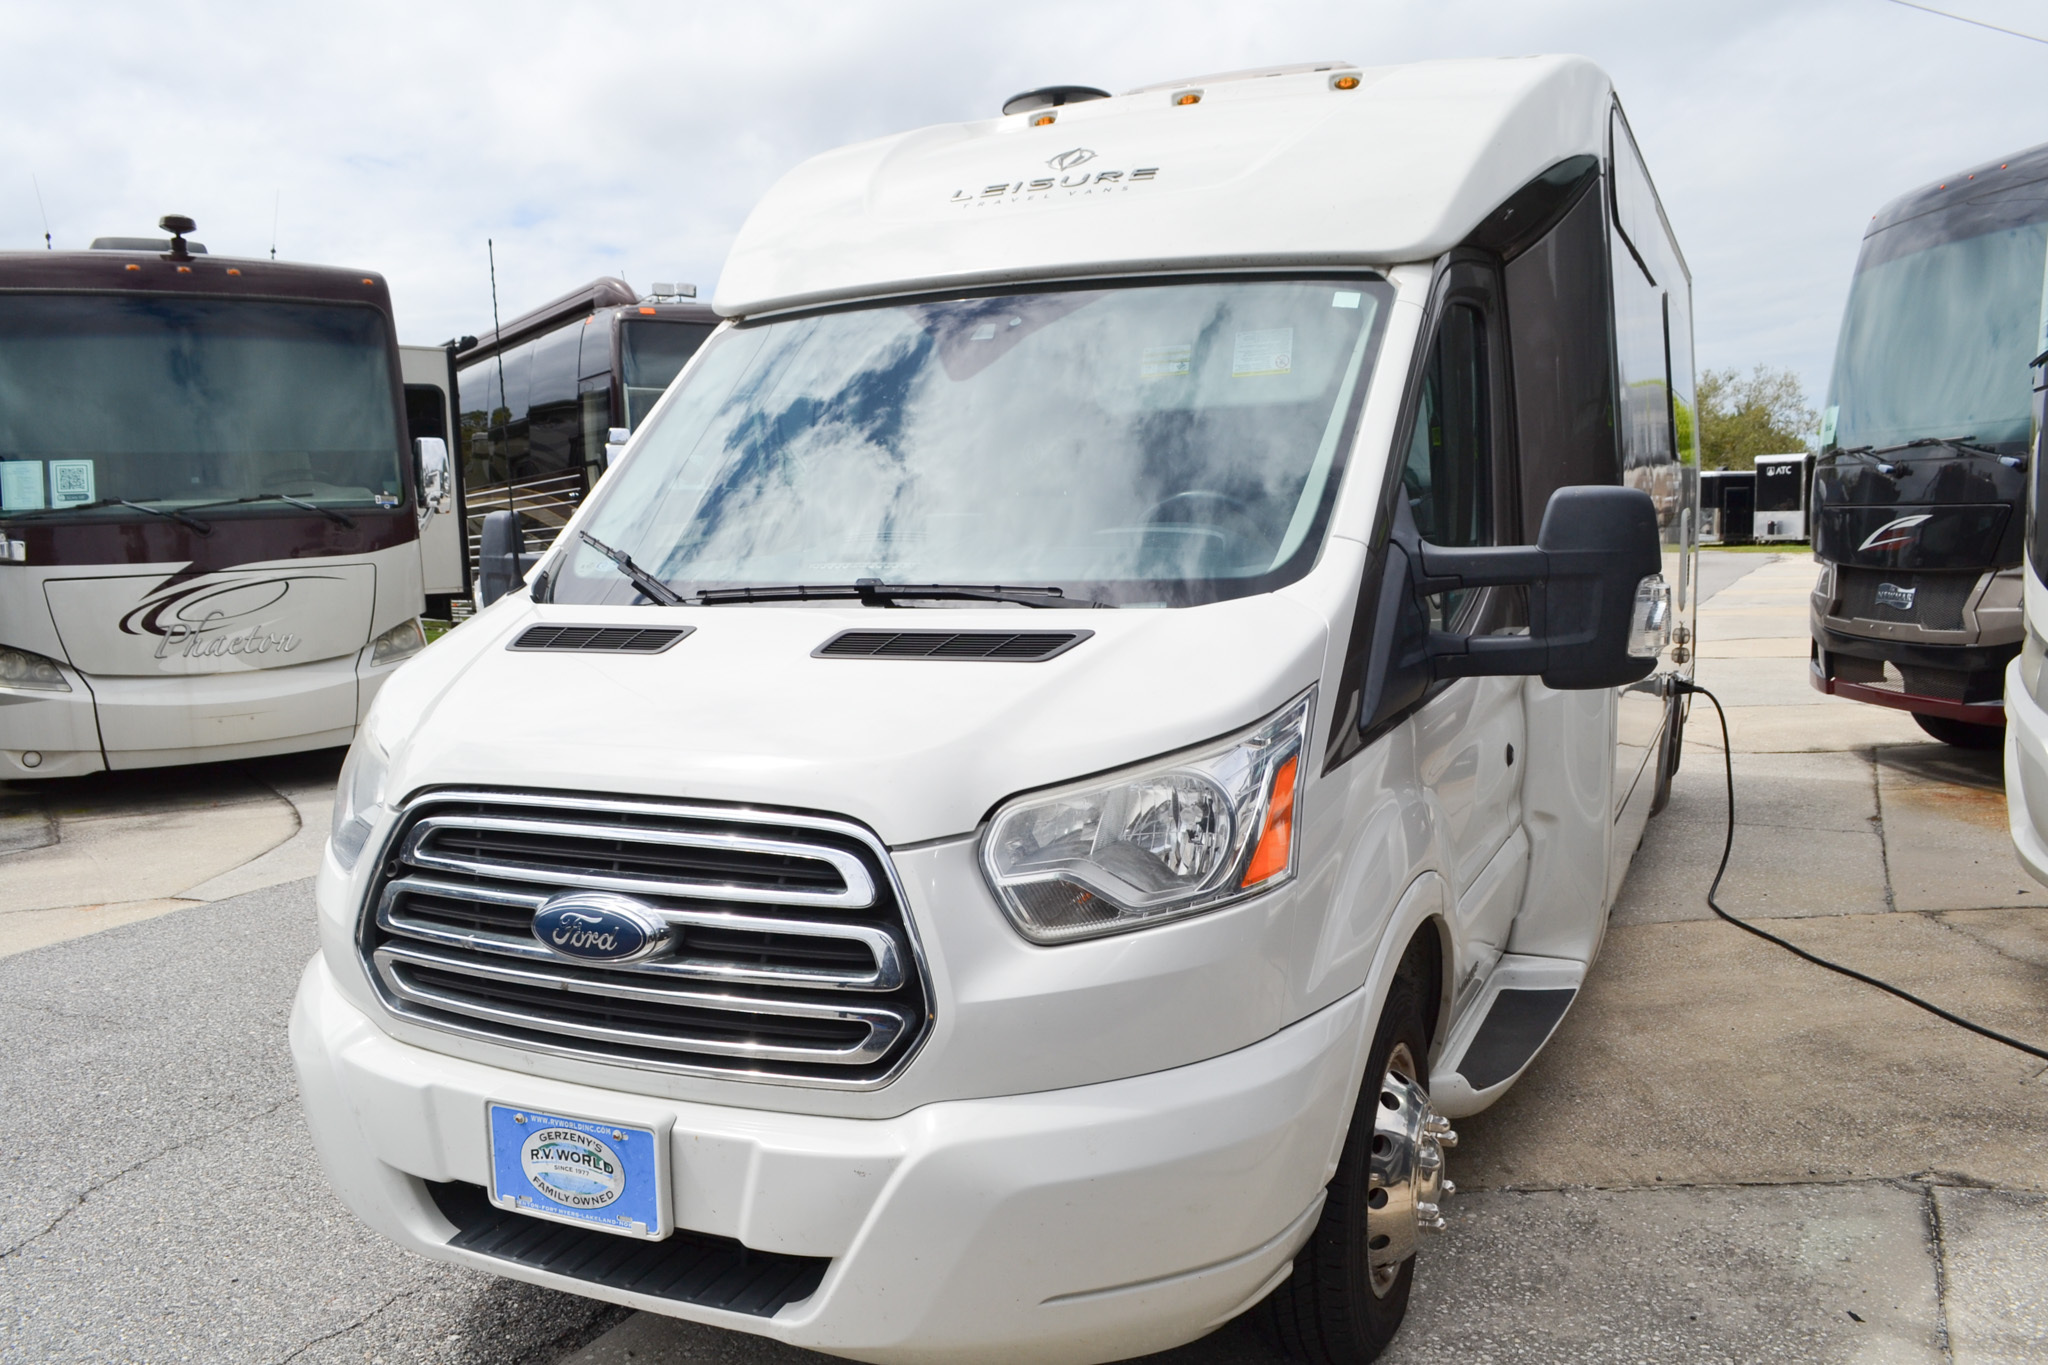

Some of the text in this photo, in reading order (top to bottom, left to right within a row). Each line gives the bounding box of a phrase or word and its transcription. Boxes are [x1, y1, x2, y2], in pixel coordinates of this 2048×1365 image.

[950, 167, 1159, 202] LEISURE
[963, 185, 1129, 208] TRAVEL VANS
[1775, 465, 1792, 475] ATC
[154, 609, 302, 659] Phaeton
[552, 912, 620, 950] Ford
[531, 1115, 611, 1135] WWW.RVWORLDINC.COM
[539, 1131, 603, 1153] GERZENY'S
[554, 1164, 573, 1173] SINCE
[556, 1149, 614, 1175] WORLD
[532, 1176, 614, 1206] FAMILY OWNED
